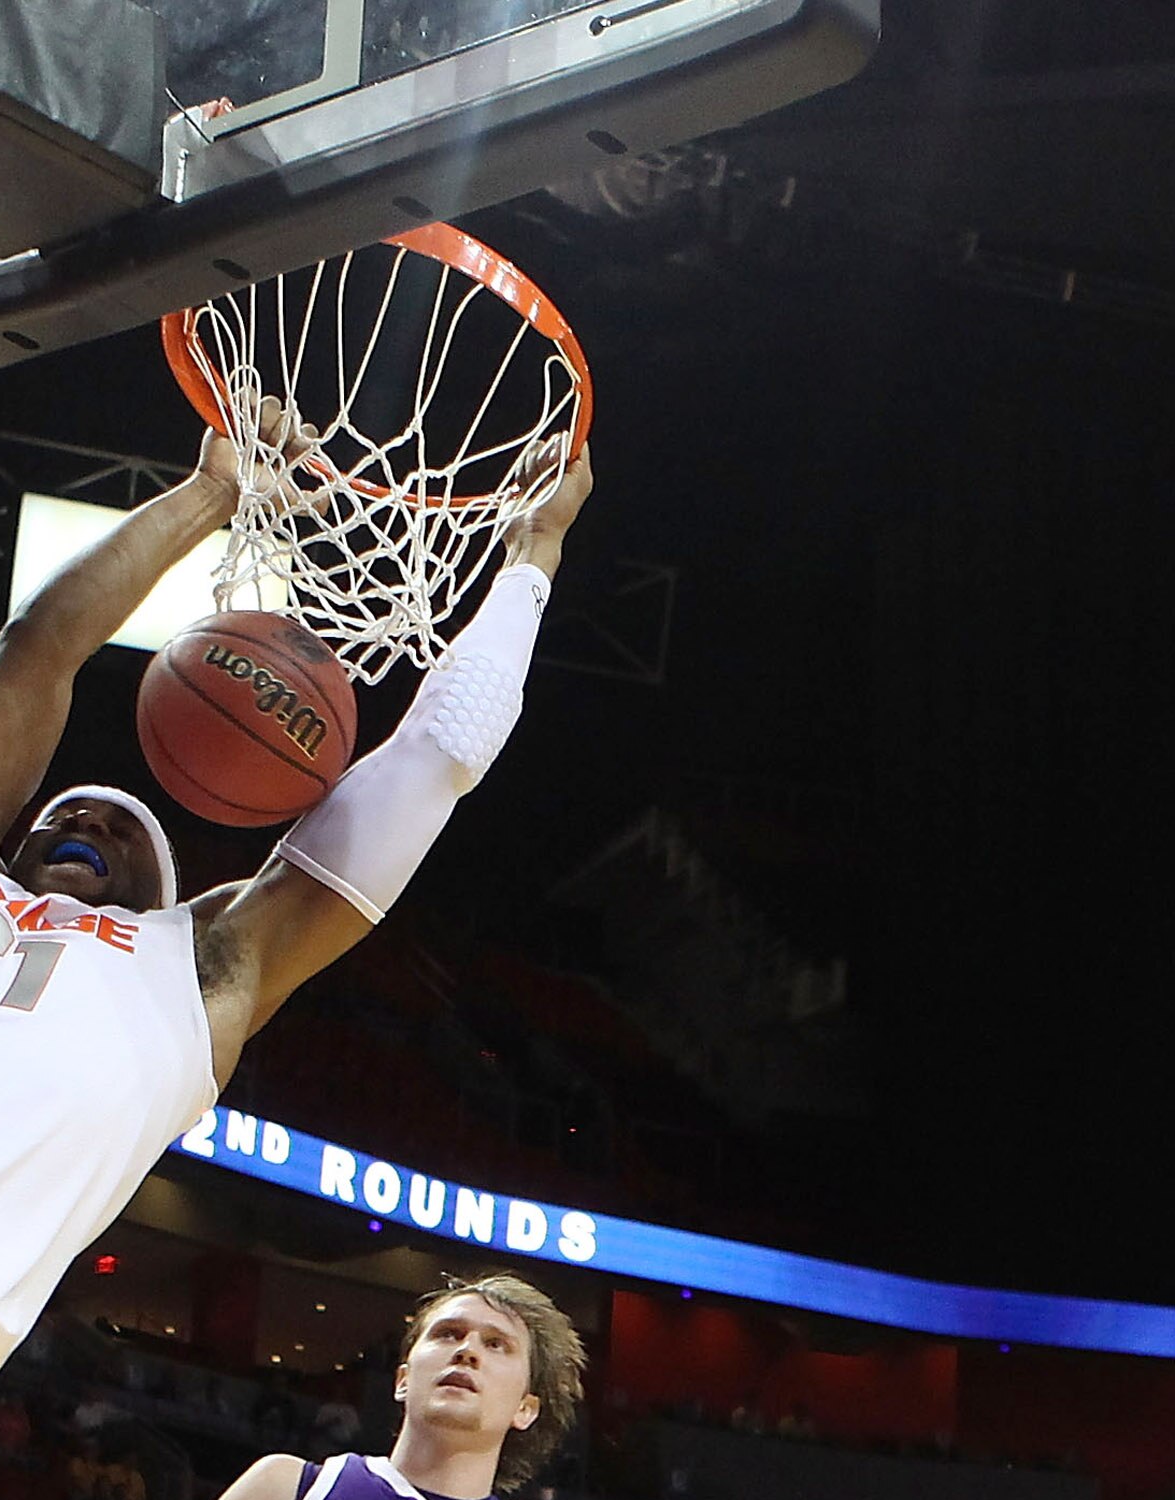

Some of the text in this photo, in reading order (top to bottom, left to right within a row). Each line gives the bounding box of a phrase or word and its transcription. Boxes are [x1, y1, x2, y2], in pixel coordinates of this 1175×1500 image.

[204, 644, 327, 761] Wilson
[181, 1109, 291, 1165] 2ND
[320, 1145, 597, 1262] ROUNDS
